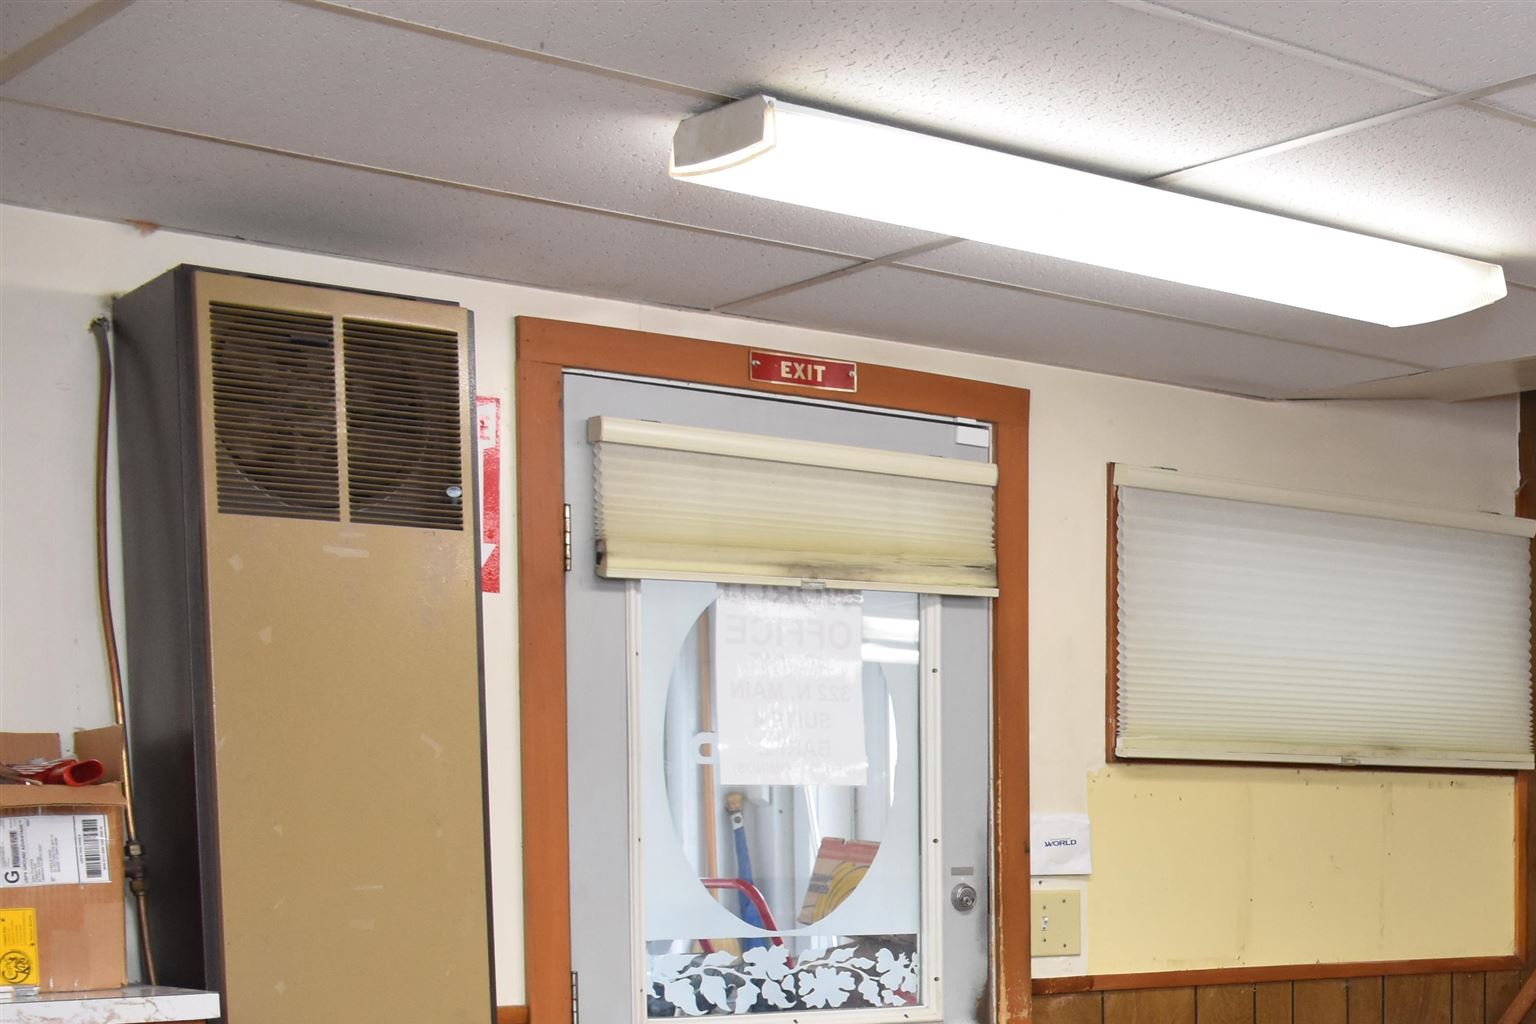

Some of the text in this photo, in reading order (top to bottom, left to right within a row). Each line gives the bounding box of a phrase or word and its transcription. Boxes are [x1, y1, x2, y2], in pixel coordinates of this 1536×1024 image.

[780, 360, 826, 382] EXIT
[1044, 839, 1077, 847] WORLD
[4, 870, 20, 884] G
